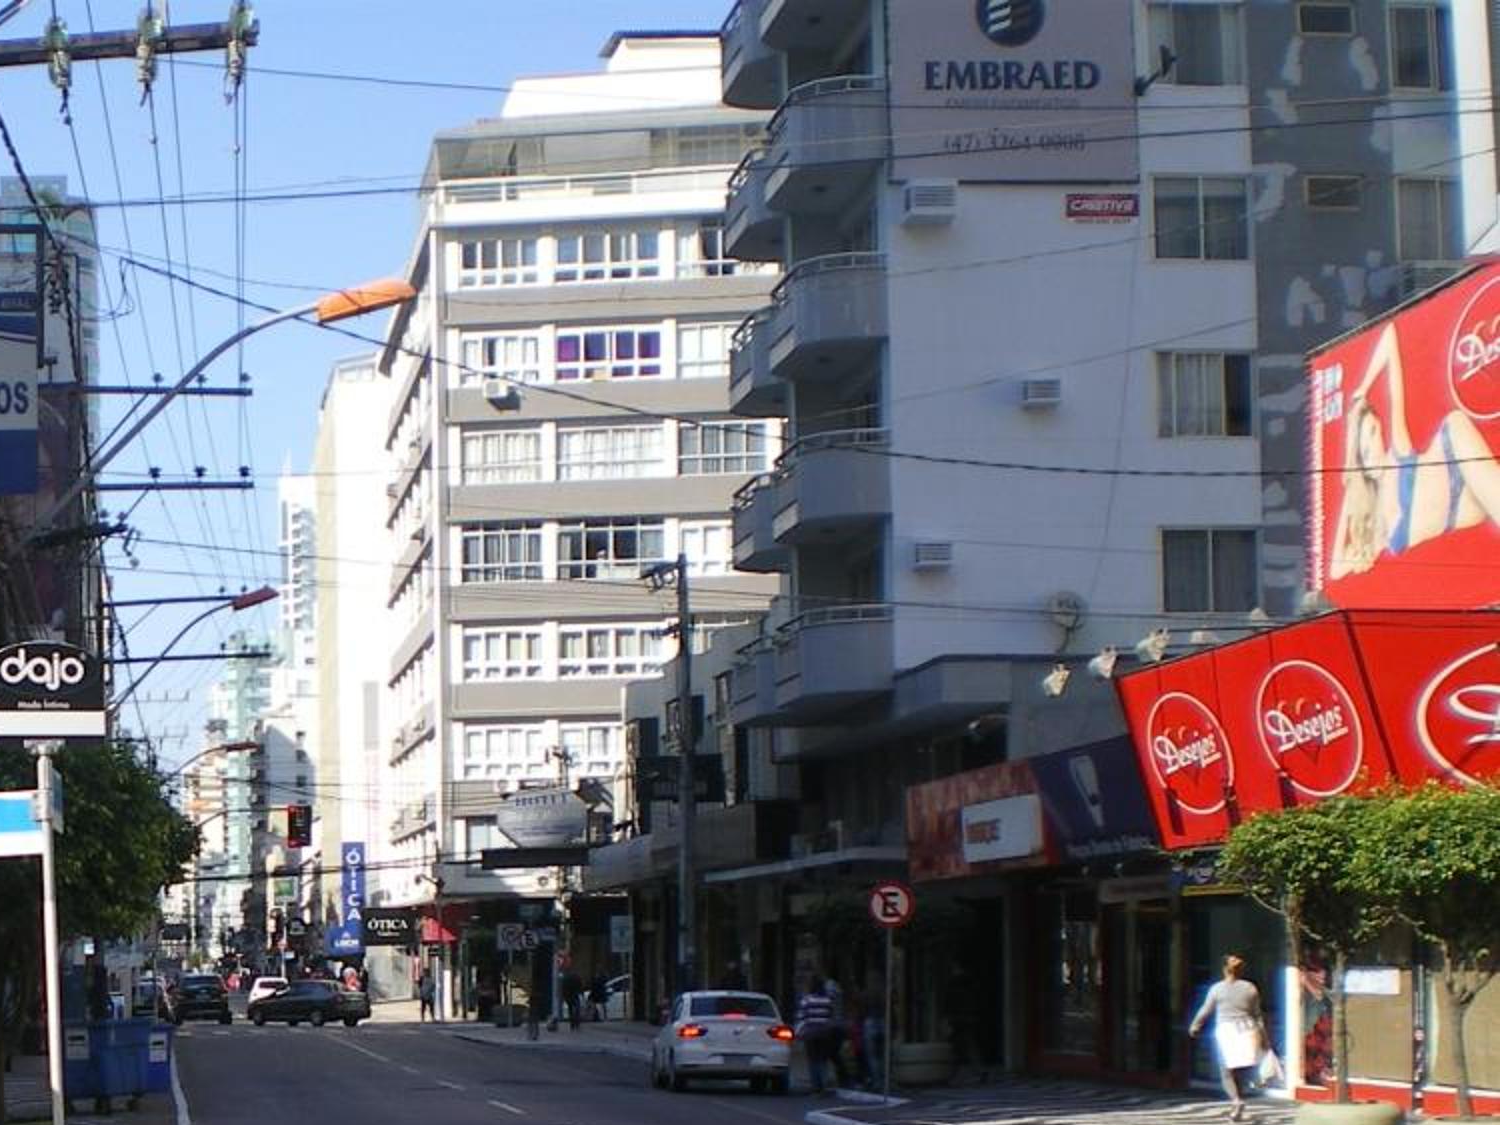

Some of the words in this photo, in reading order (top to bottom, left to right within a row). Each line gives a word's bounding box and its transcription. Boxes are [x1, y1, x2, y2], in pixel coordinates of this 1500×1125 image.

[924, 60, 1100, 91] EMBRAED
[0, 648, 85, 691] dajo
[1265, 704, 1349, 752] Desejos
[345, 847, 362, 921] ÓTICA
[367, 917, 409, 930] ÓTICA
